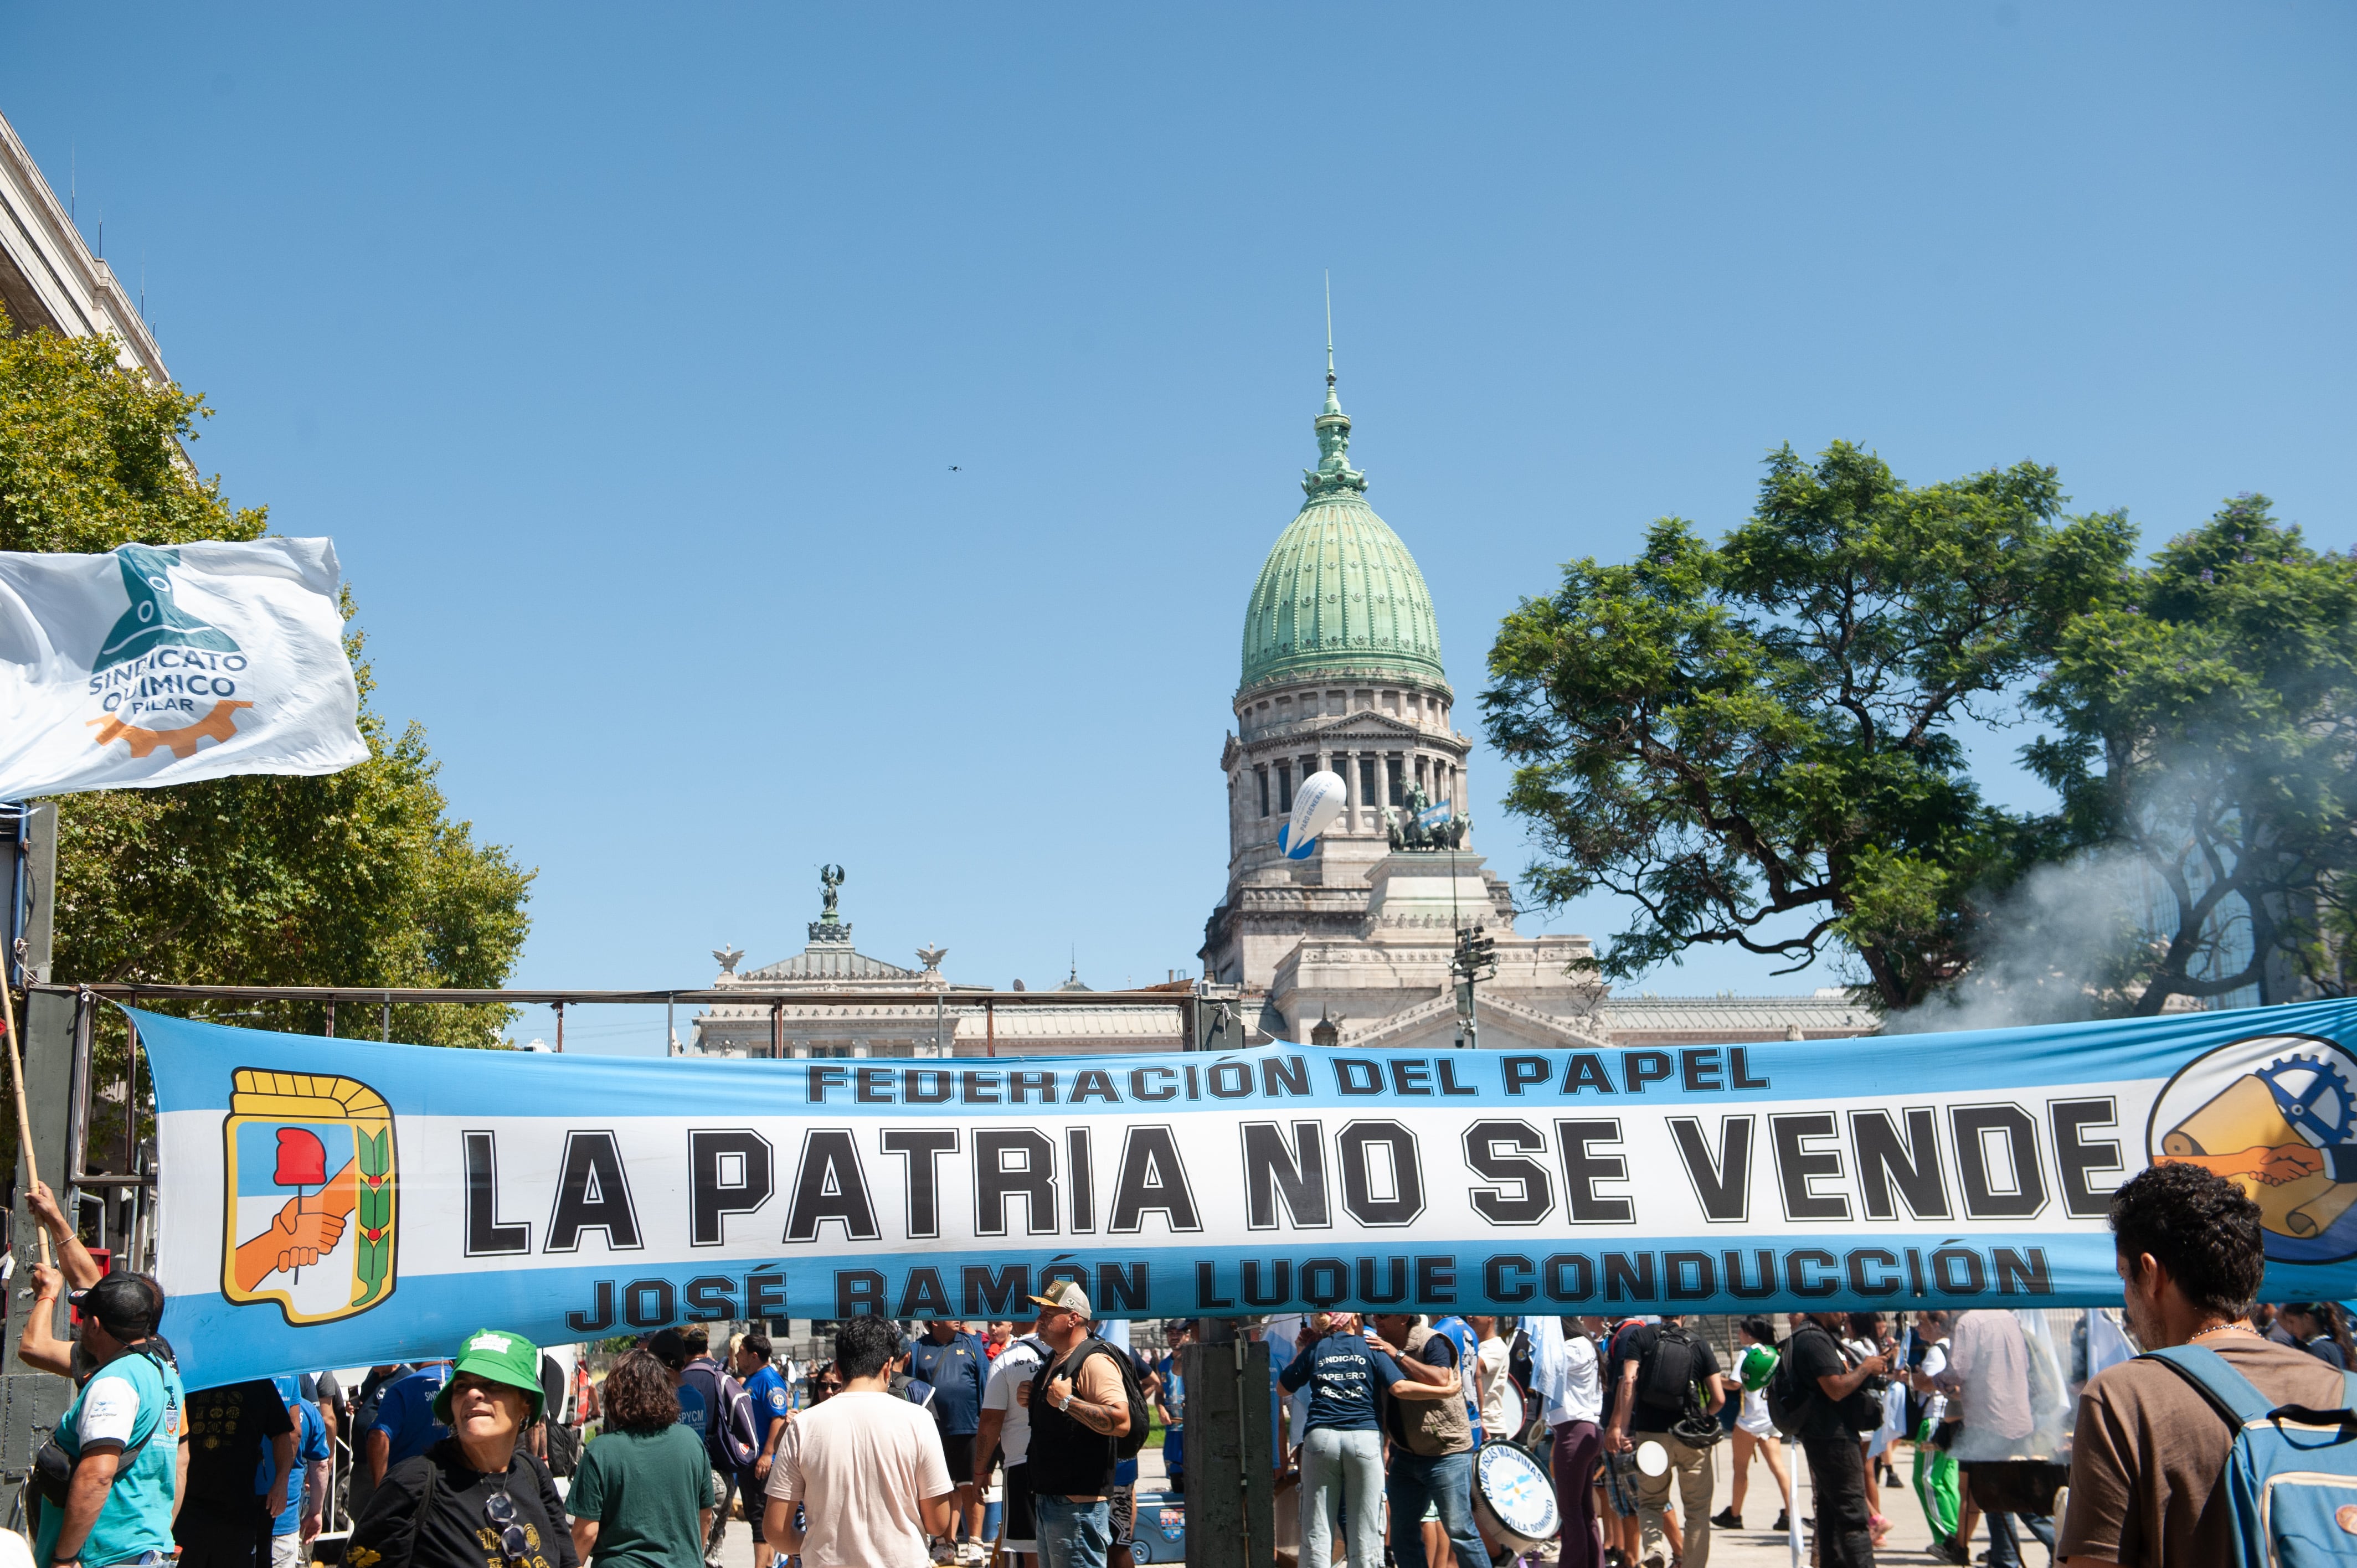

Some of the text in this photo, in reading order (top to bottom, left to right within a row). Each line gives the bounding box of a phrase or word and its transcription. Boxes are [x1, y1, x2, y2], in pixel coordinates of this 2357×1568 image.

[89, 649, 247, 695] SINDICATO
[103, 674, 235, 712] QUIMICO
[132, 698, 194, 714] PILAR
[1300, 816, 1310, 831] PARO
[1307, 788, 1326, 816] GENERAL
[806, 1046, 1770, 1105] FEDERACIÓN DEL PAPEL
[461, 1096, 2125, 1258] LA PATRIA NO SE VENDE
[565, 1263, 789, 1333] JOSÉ
[1195, 1255, 1457, 1310] LUQUE
[1482, 1239, 2055, 1304] CONDUCCIÓN
[1317, 1372, 1366, 1381] PAPELERO
[1318, 1355, 1366, 1367] SINDICATO
[1320, 1386, 1366, 1399] BECCAR
[1481, 1447, 1498, 1469] ISLAS
[1497, 1446, 1543, 1483] MALVINAS
[1503, 1499, 1553, 1533] VILLA DOMINICO
